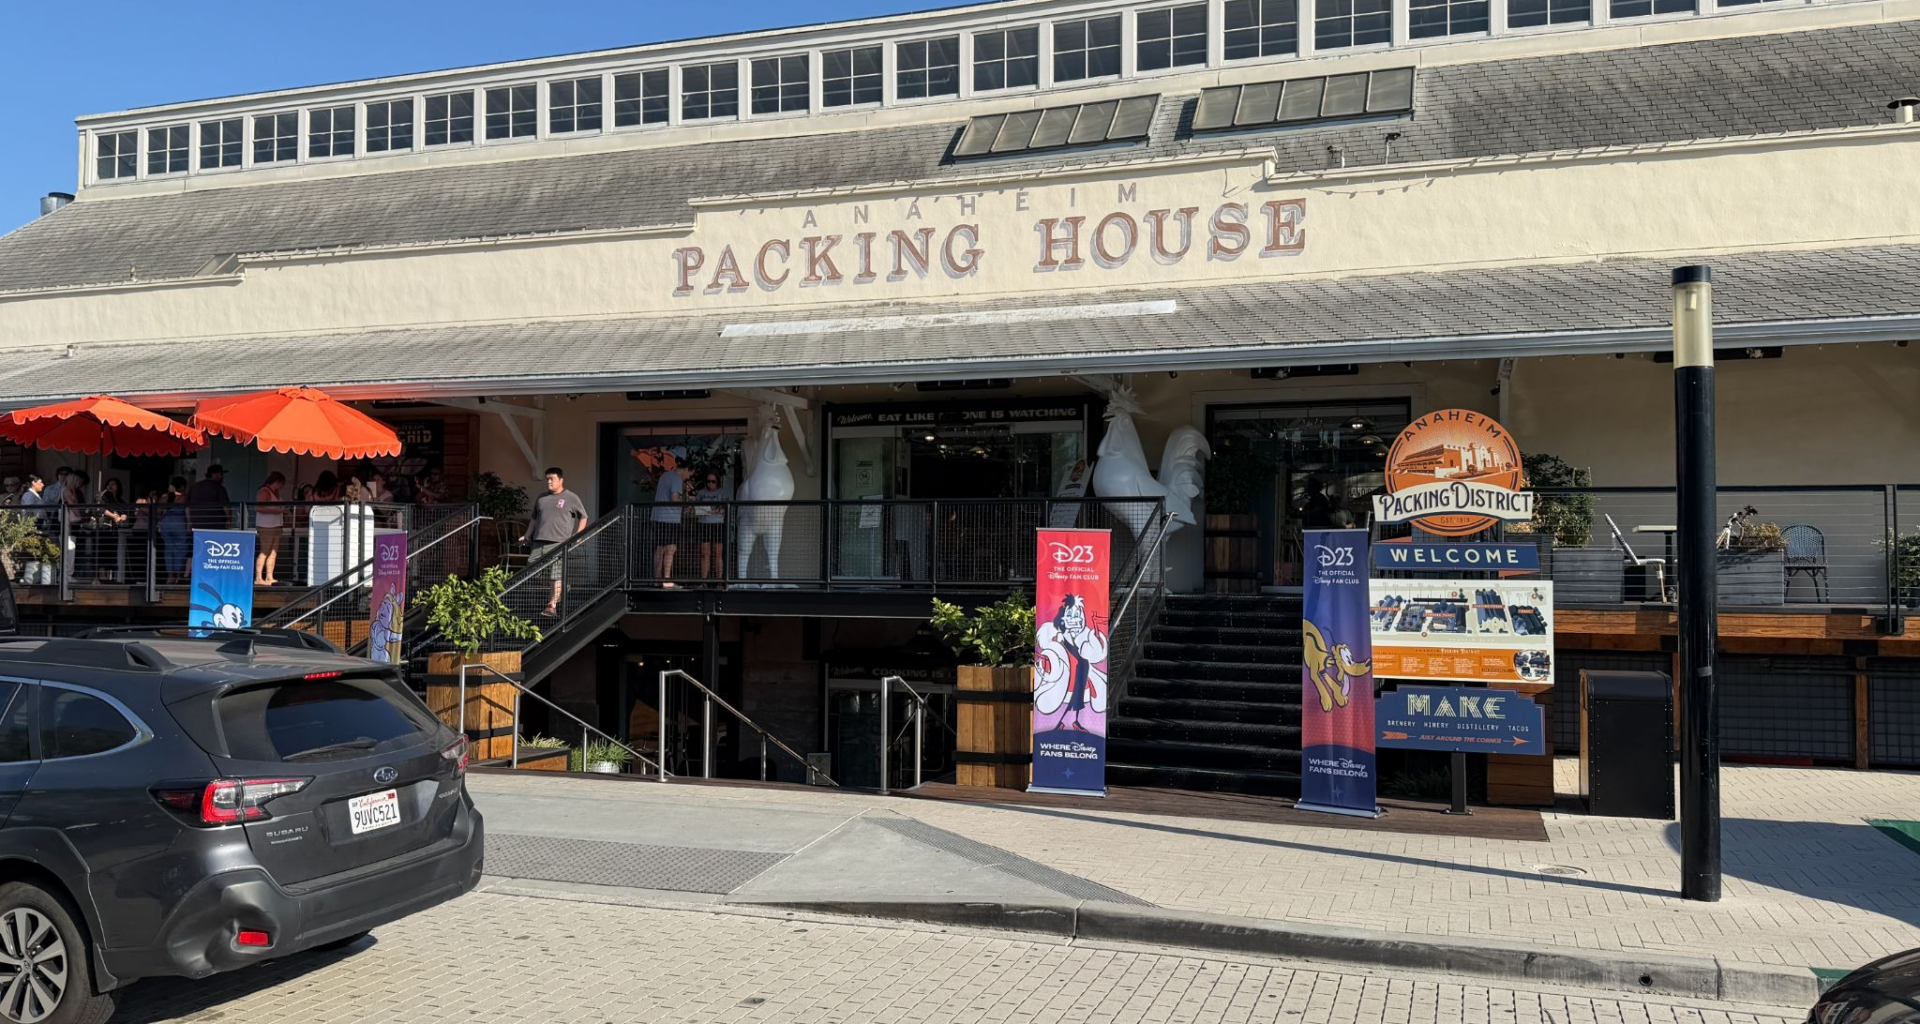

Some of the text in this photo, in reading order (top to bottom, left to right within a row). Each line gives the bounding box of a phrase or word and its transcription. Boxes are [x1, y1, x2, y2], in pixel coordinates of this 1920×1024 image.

[802, 182, 1137, 229] ANAHEIM
[672, 198, 1306, 297] PACKING HOUSE
[905, 412, 934, 421] LIKE
[991, 410, 1004, 419] IS
[1008, 408, 1076, 418] WATCHING
[1403, 411, 1502, 443] ANAHEIM
[398, 430, 432, 443] CHID
[1379, 481, 1532, 521] PACKING DISTRICT
[204, 540, 241, 557] D23
[380, 543, 399, 561] D23
[1049, 542, 1094, 563] D23
[1314, 544, 1354, 567] D23
[1390, 548, 1519, 564] WELCOME
[202, 562, 219, 571] Disney
[1047, 571, 1068, 582] Disney
[1313, 575, 1330, 587] Disney
[872, 667, 927, 678] COOKING
[1407, 693, 1507, 719] MAKE
[1423, 721, 1449, 729] WINERY
[1457, 723, 1499, 731] DISTILLERY
[1040, 750, 1098, 760] FANS BELONG
[1070, 741, 1096, 755] Disney
[1309, 757, 1365, 772] WHERE Disney
[1309, 765, 1368, 778] FANS BELONG
[359, 797, 386, 808] California
[354, 802, 397, 828] 9UVC521
[266, 826, 309, 837] SUBARU
